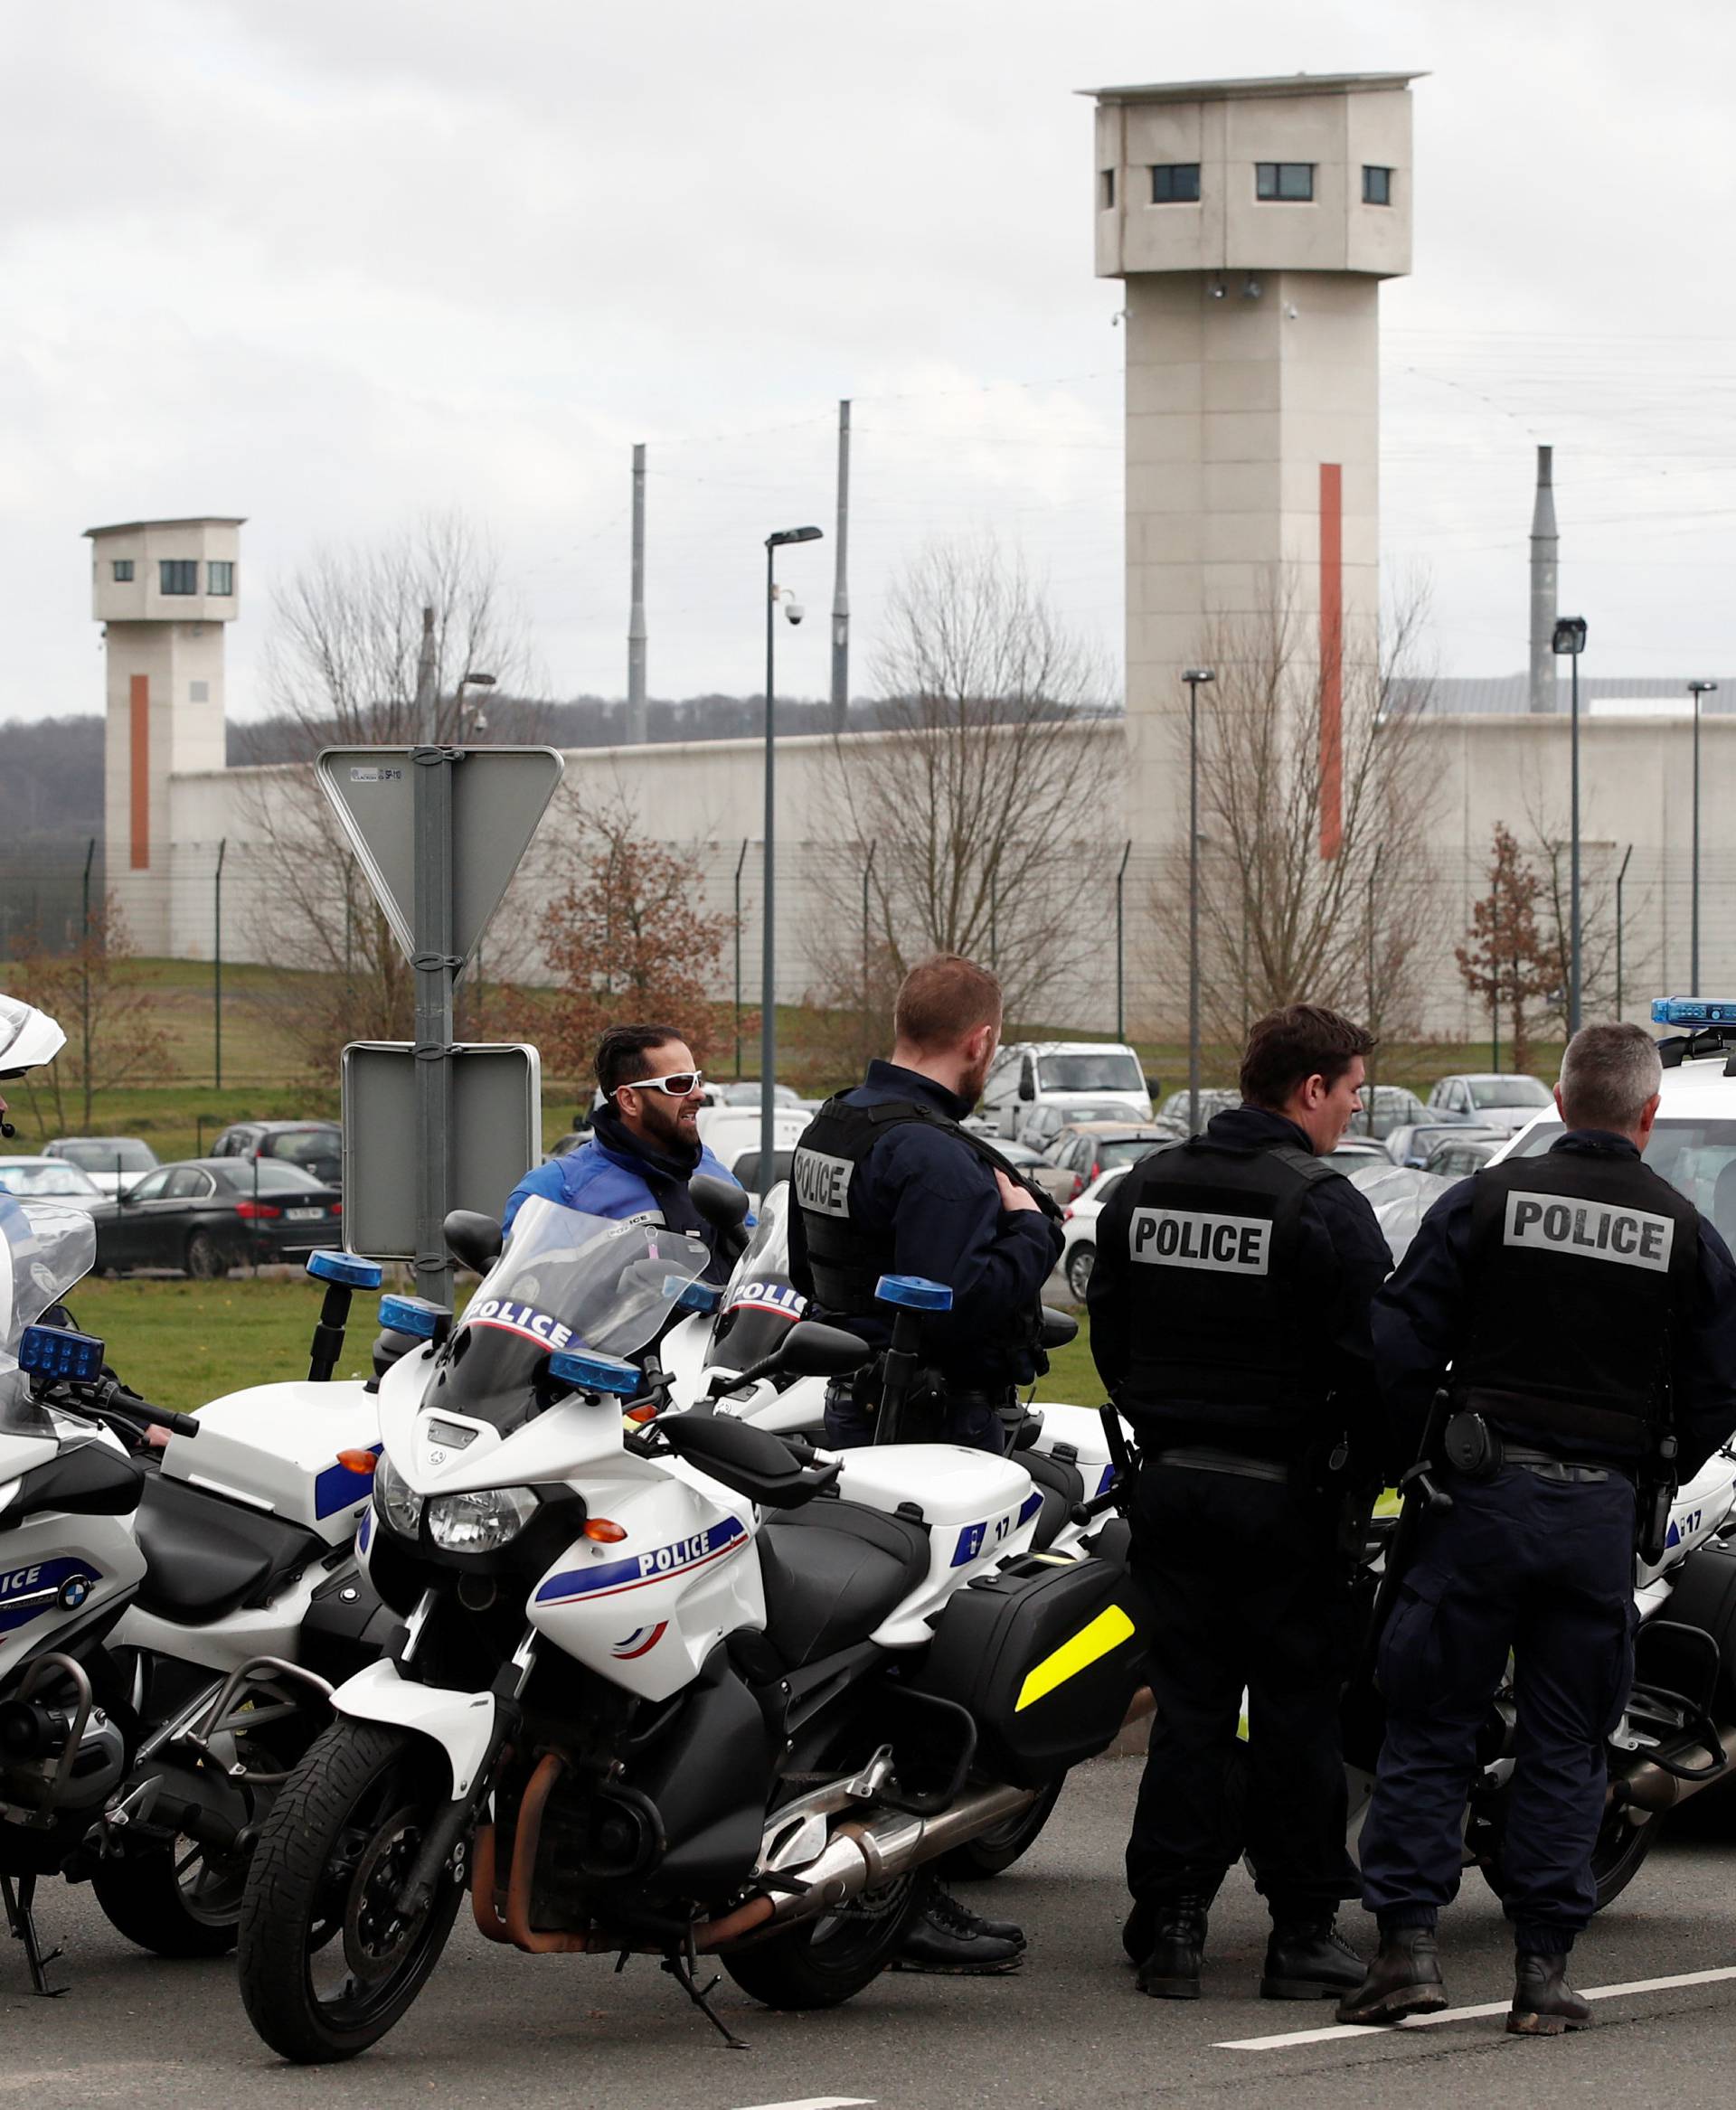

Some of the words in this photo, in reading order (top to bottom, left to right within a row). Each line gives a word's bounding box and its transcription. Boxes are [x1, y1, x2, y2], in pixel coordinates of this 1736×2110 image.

[797, 1155, 845, 1208] POLICE
[1136, 1217, 1262, 1265] POLICE
[1514, 1201, 1665, 1260] POLICE
[466, 1300, 572, 1349] POLICE
[995, 1515, 1009, 1541] 17
[1686, 1509, 1702, 1533] 17
[637, 1531, 710, 1578] POLICE
